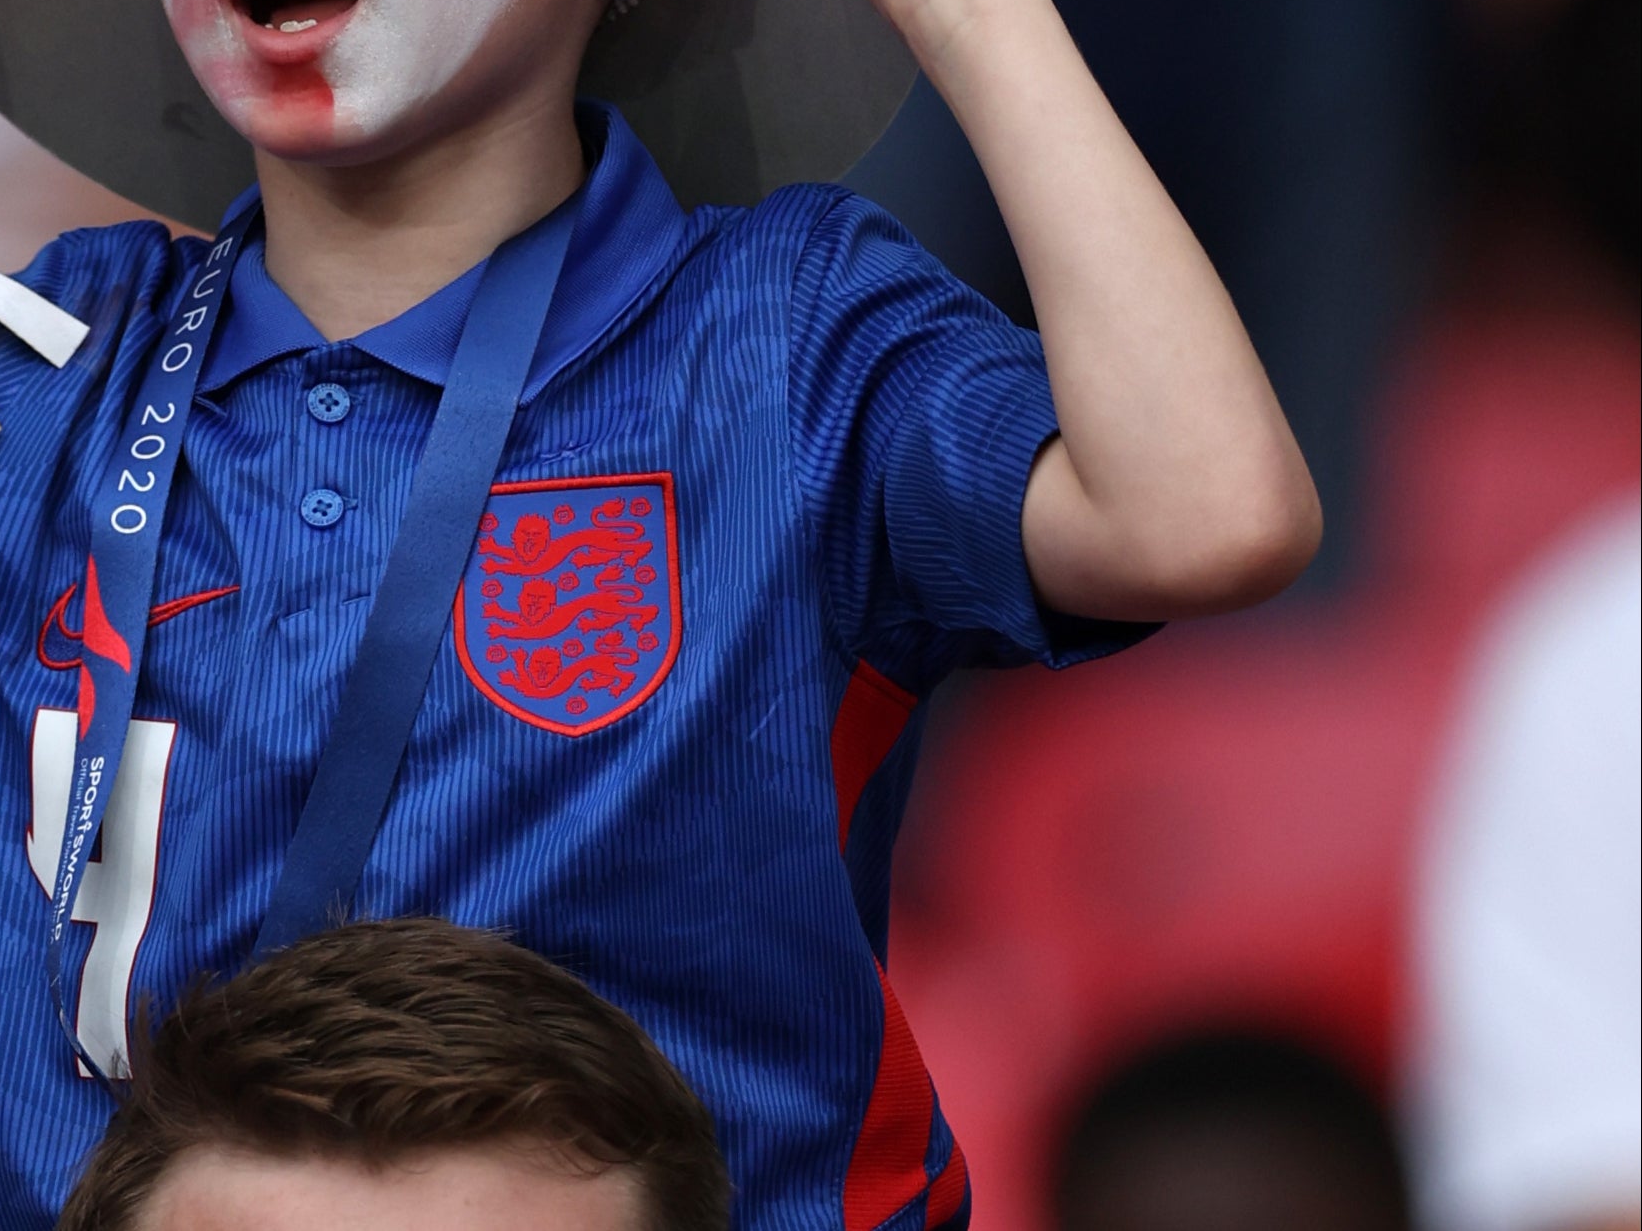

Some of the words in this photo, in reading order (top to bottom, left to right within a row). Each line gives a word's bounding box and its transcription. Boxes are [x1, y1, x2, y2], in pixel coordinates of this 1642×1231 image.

[162, 236, 233, 372] EURO
[111, 402, 175, 534] 2020
[55, 756, 104, 941] SPORTSWORLD
